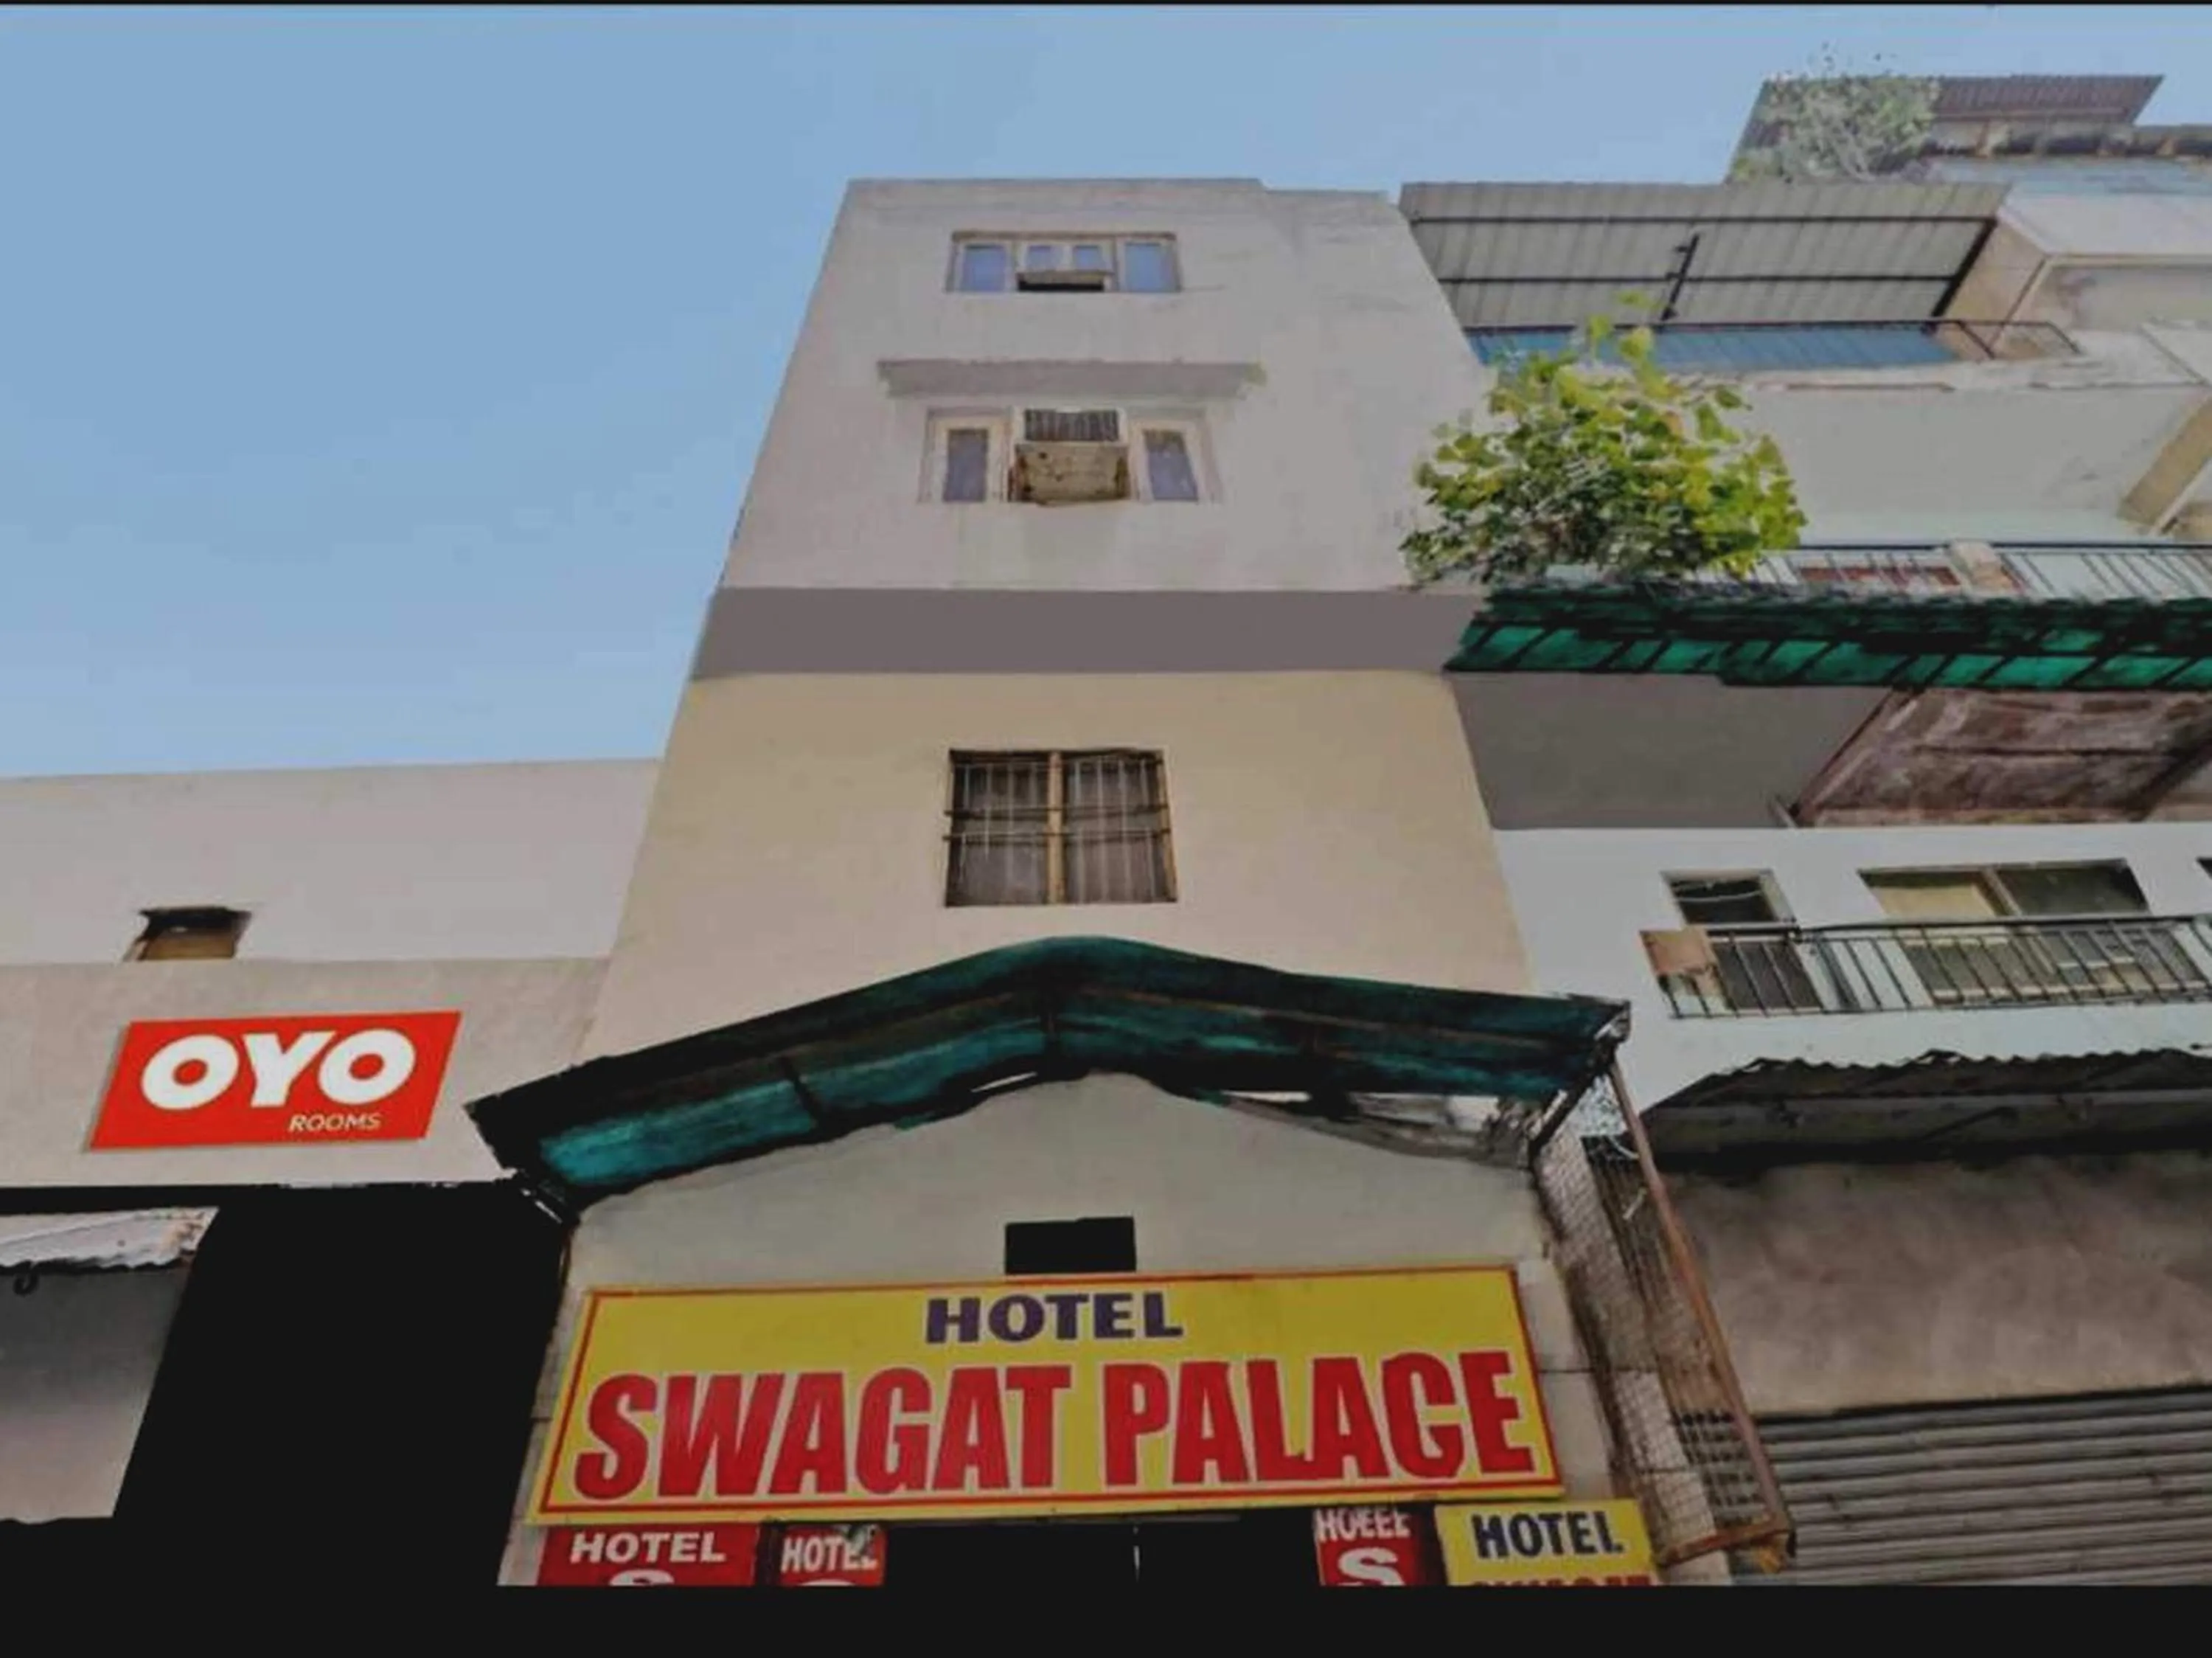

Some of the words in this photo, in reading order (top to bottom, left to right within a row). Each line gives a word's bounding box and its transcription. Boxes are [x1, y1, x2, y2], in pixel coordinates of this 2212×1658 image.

[141, 1027, 416, 1111] OYO
[288, 1112, 382, 1133] ROOMS
[924, 1292, 1184, 1345] HOTEL
[574, 1364, 1072, 1502] SWAGAT
[1103, 1350, 1536, 1488] PALACE
[568, 1530, 727, 1565] HOTEL
[780, 1534, 878, 1575] HOTEL
[1470, 1509, 1625, 1560] HOTEL
